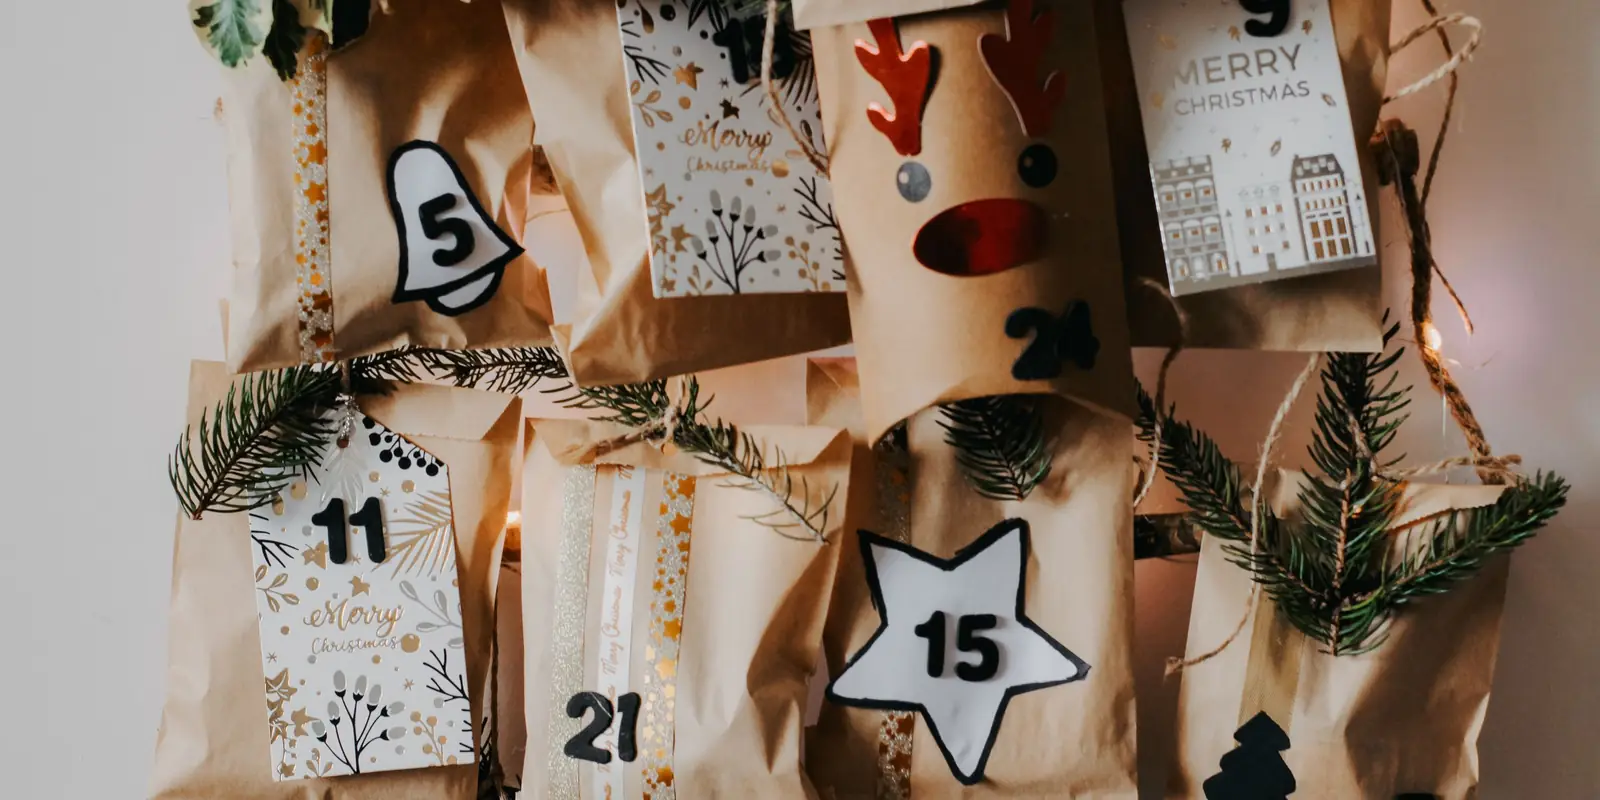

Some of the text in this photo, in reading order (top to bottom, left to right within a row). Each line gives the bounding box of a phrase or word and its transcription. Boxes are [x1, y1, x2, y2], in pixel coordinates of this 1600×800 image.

[1173, 44, 1301, 89] MERRY
[1174, 80, 1310, 116] CHRISTMAS
[678, 119, 773, 161] Merry
[687, 156, 771, 174] Christmas
[418, 192, 475, 267] 5
[1005, 299, 1100, 380] 24
[311, 497, 386, 565] 11
[303, 599, 405, 638] Merry
[312, 635, 402, 655] Christmas
[914, 610, 1000, 682] 15
[564, 691, 641, 764] 21
